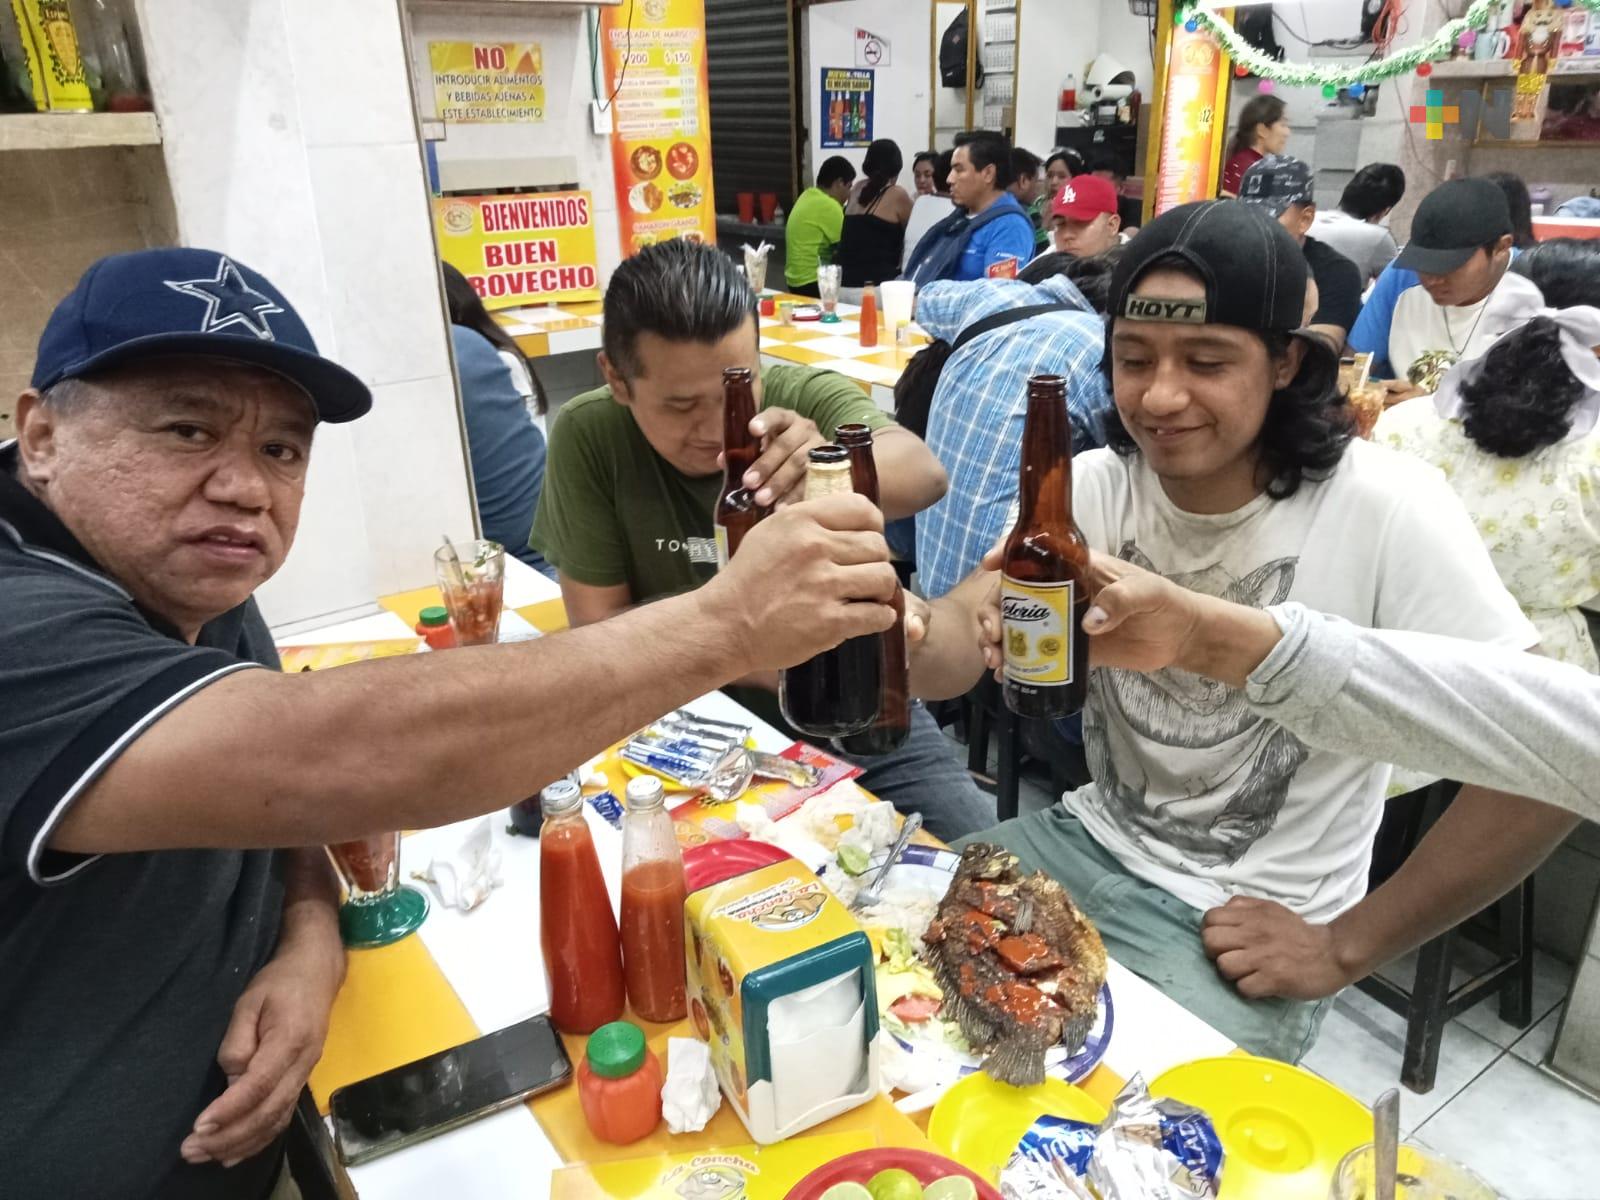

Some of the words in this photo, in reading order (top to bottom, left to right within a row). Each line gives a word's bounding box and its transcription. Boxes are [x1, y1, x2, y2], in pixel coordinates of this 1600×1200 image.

[474, 47, 505, 70] NO
[435, 74, 490, 86] INTRODUCIR
[493, 74, 543, 86] ALIMENTOS
[446, 91, 452, 101] Y
[454, 91, 492, 103] BEBIDAS
[494, 91, 527, 103] AJENAS
[529, 93, 536, 101] A
[442, 108, 463, 120] ESTE
[465, 108, 543, 120] ESTABLECIMIENTO
[481, 198, 589, 232] BIENVENIDOS
[484, 240, 557, 268] BUEN
[466, 266, 595, 298] ROVECHO
[1128, 300, 1201, 319] HOYT
